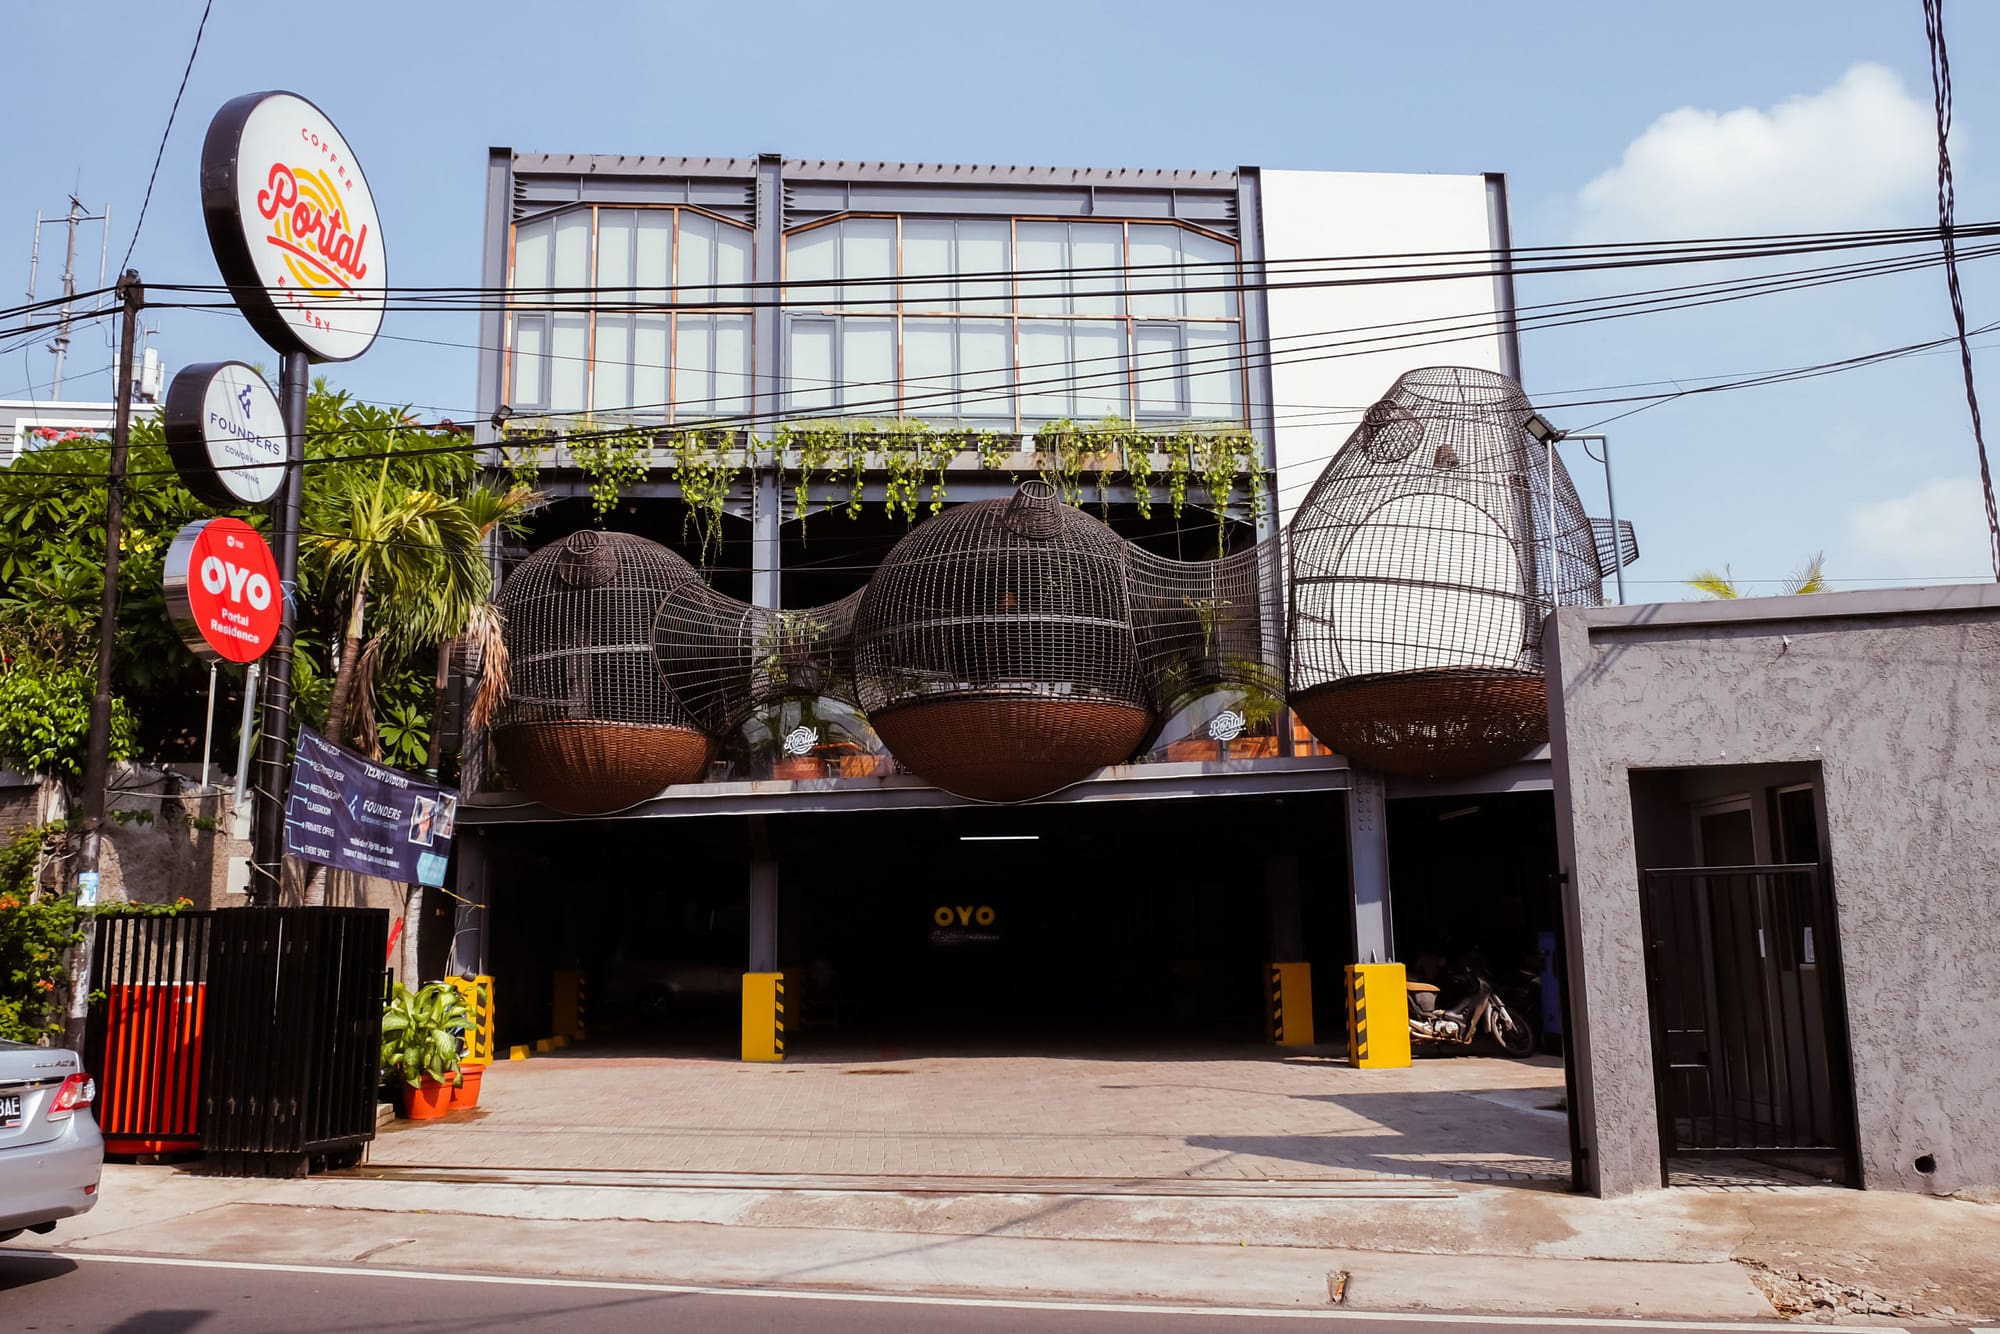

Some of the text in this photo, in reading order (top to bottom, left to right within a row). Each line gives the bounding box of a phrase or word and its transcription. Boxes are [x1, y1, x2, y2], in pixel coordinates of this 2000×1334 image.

[301, 127, 353, 191] COFFEE
[256, 162, 368, 280] Portal
[210, 412, 280, 456] FOUNDERS
[201, 555, 272, 611] OYO
[210, 618, 260, 645] Residence
[221, 607, 249, 626] Portal
[362, 799, 402, 821] FOUNDERS
[934, 905, 996, 927] OYO
